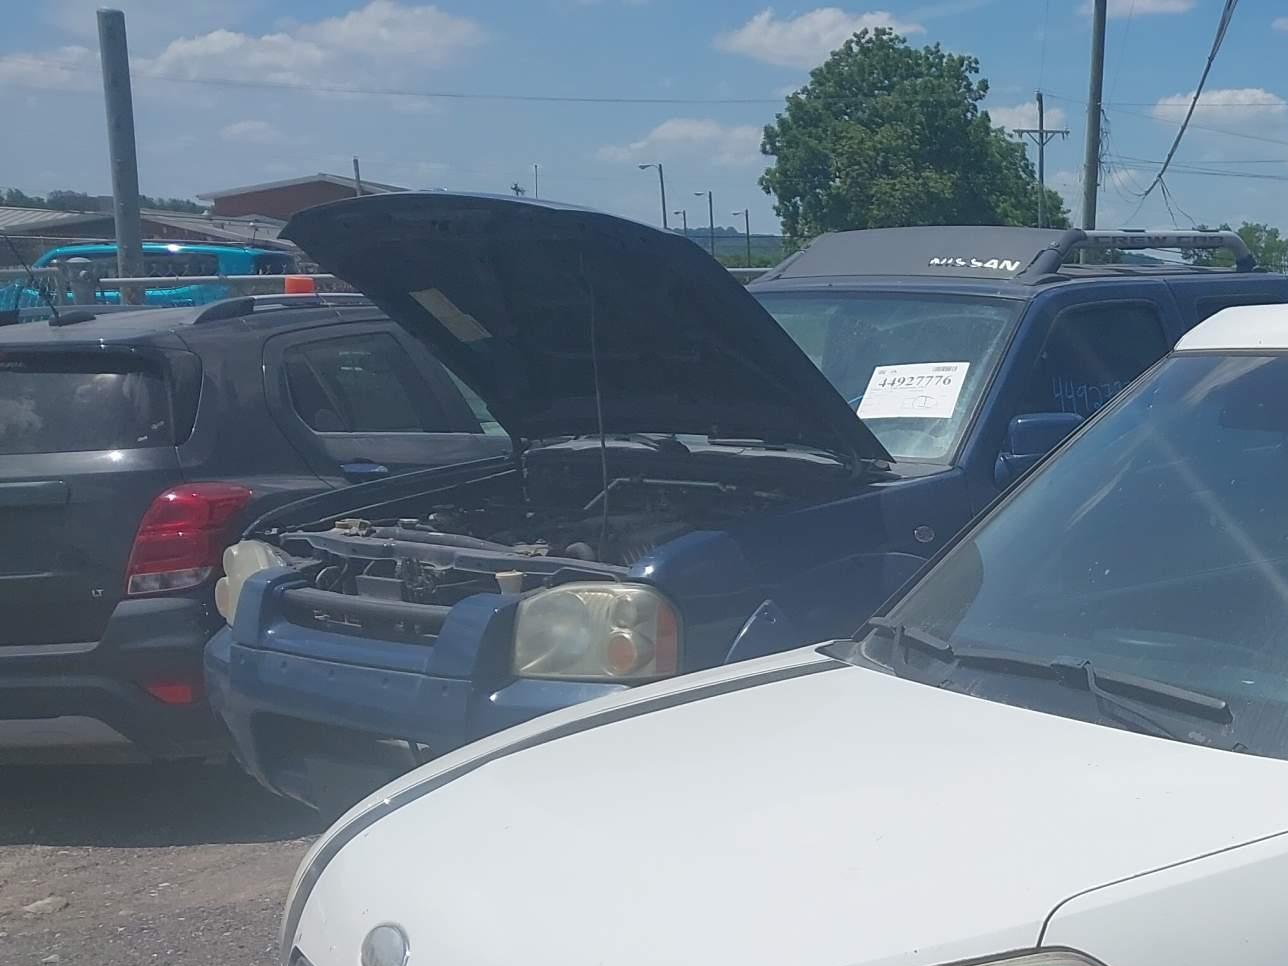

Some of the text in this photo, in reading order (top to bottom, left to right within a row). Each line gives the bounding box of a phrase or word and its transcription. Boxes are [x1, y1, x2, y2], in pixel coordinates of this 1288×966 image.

[929, 257, 1021, 271] NISSAN
[878, 375, 952, 388] 44927776
[91, 588, 105, 598] LT
